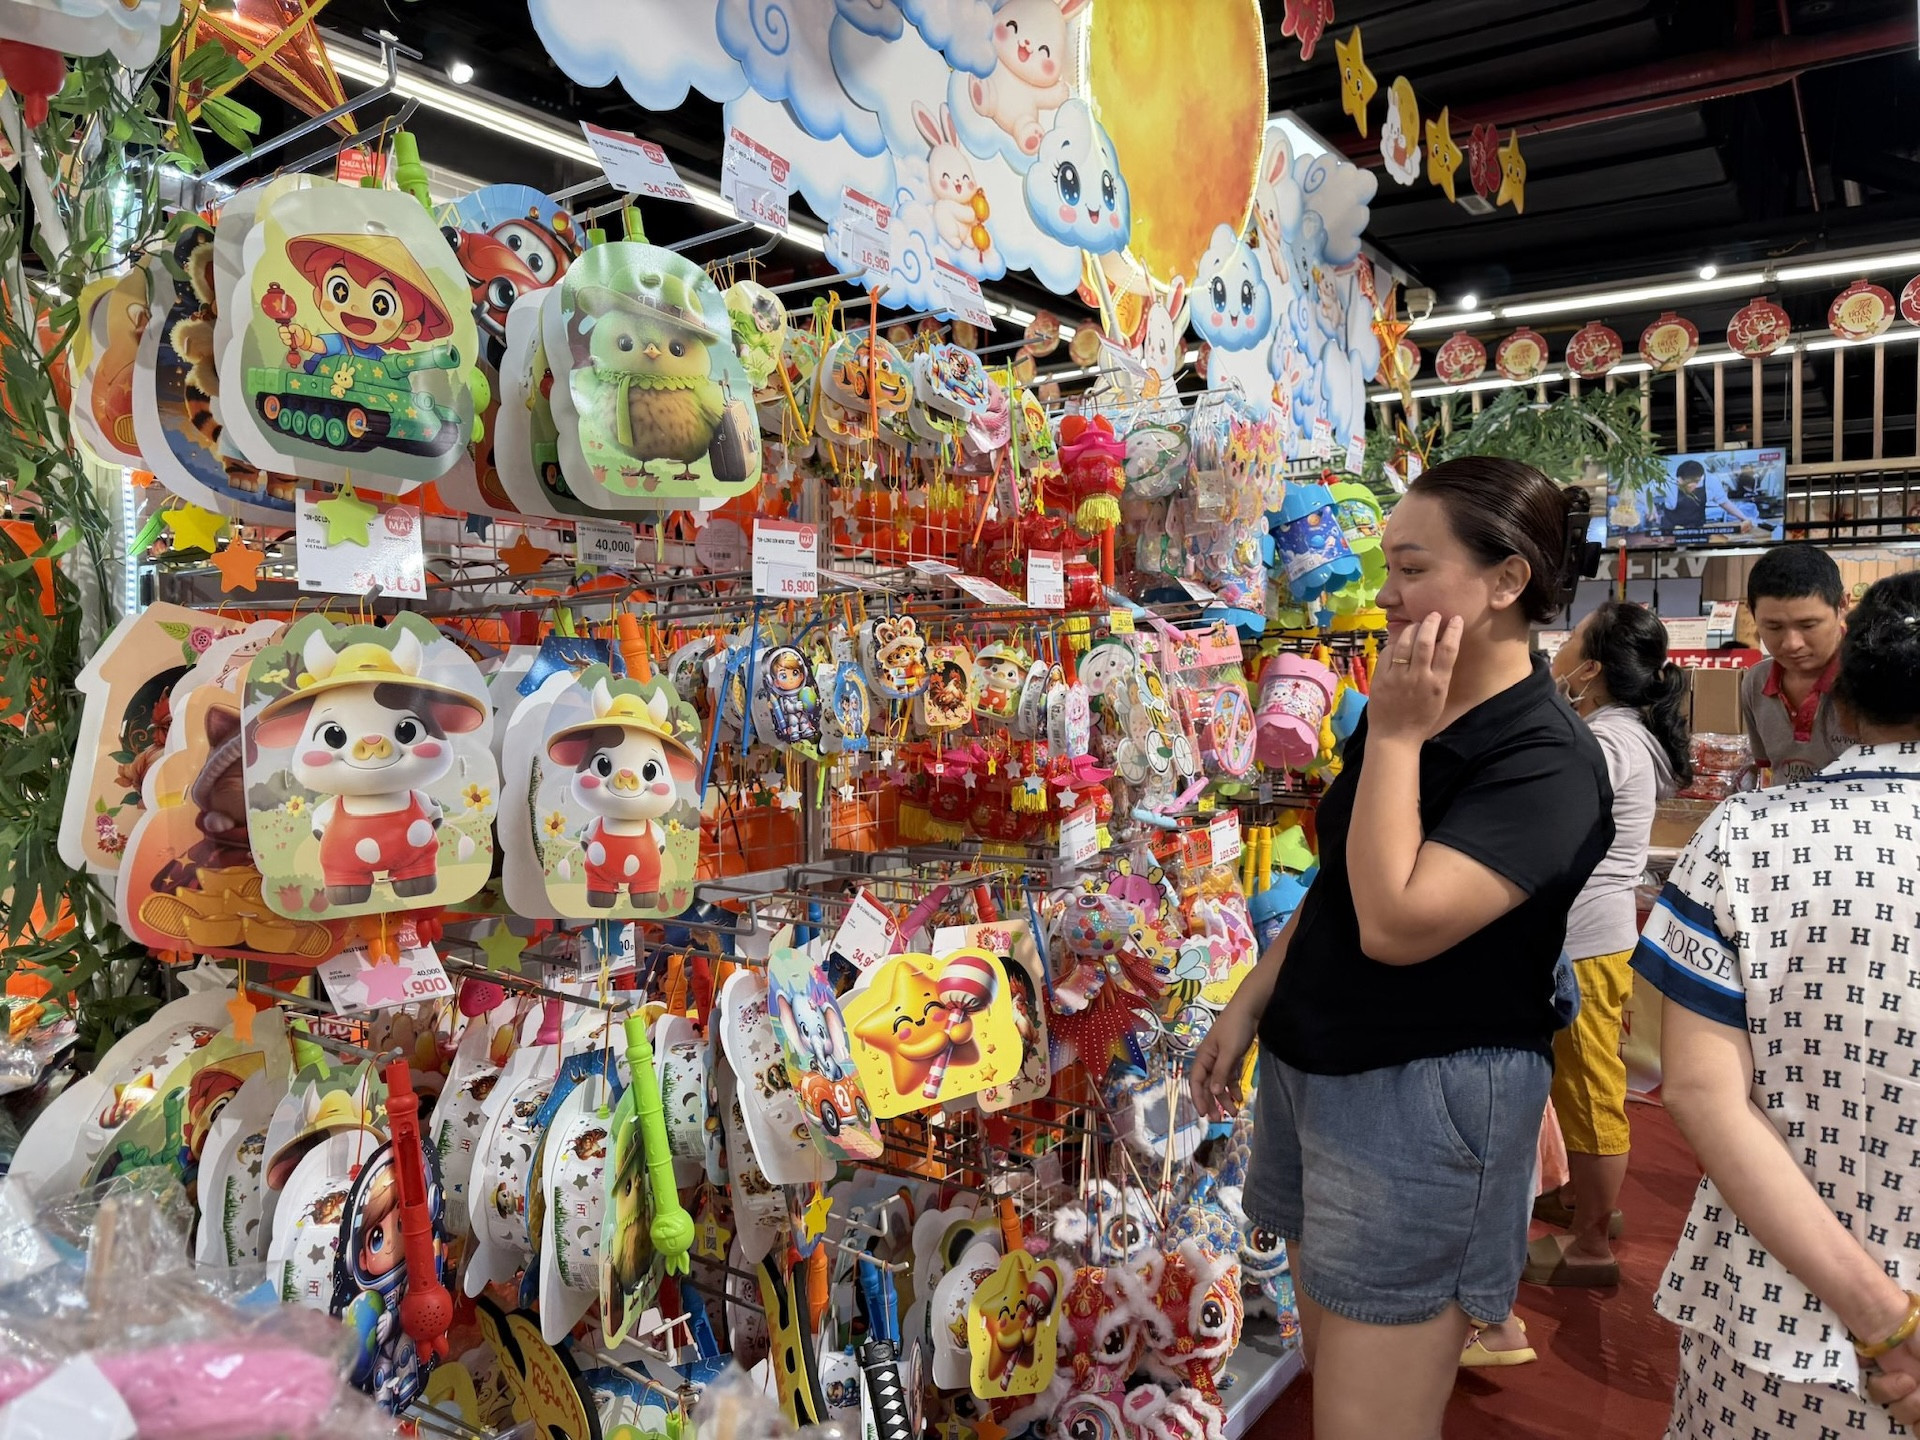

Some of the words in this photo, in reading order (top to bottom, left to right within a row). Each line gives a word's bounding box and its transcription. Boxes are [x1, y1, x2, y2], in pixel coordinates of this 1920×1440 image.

[781, 579, 814, 594] 16,900
[1660, 920, 1735, 981] HORSE
[416, 968, 440, 977] 40,000
[402, 977, 447, 998] ,900
